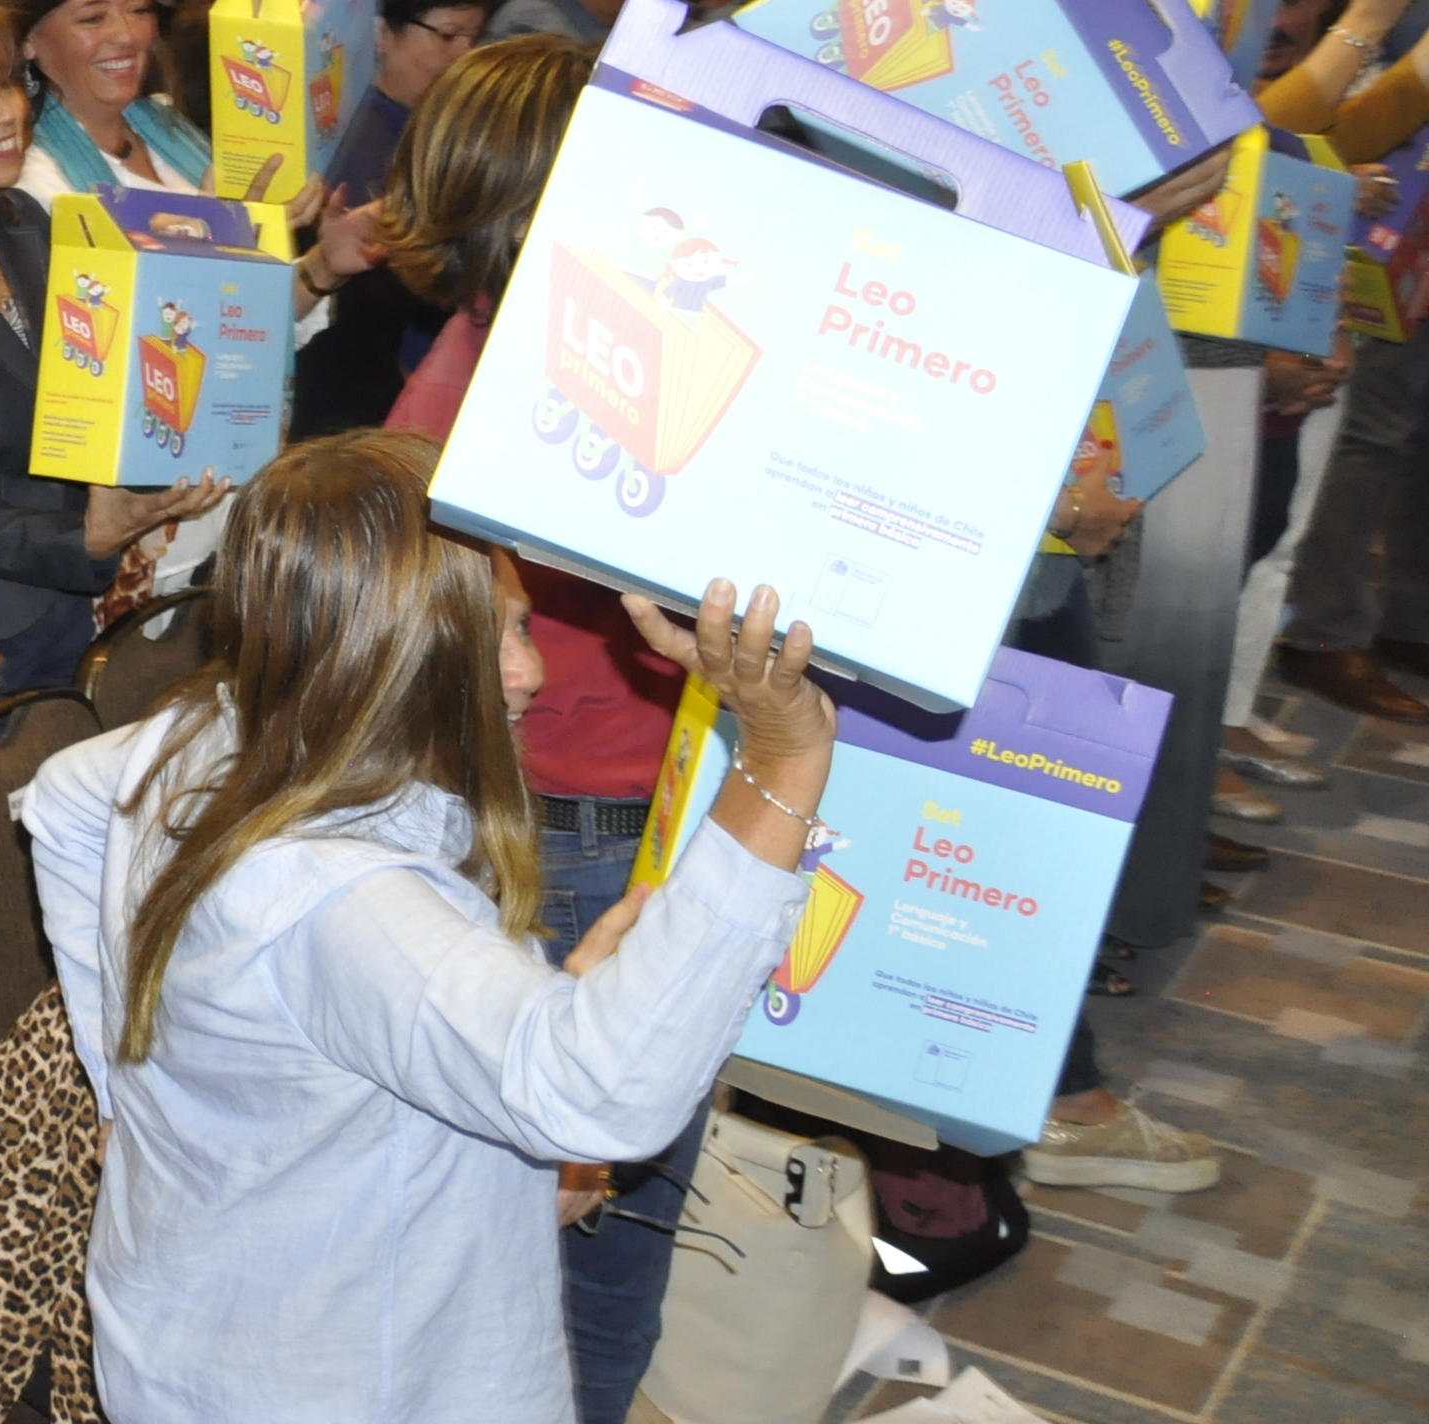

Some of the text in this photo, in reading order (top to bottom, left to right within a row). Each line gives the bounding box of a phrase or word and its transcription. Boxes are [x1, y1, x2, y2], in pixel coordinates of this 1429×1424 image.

[230, 68, 263, 94] LEO
[1015, 60, 1050, 107] Leo
[1108, 38, 1180, 146] #LeoPrimero
[989, 73, 1056, 170] Primero
[851, 227, 904, 267] Set
[220, 301, 243, 318] Leo
[832, 260, 917, 317] Leo
[62, 311, 91, 339] LEO
[218, 323, 267, 342] Primero
[561, 298, 644, 398] LEO
[817, 304, 997, 396] Primero
[144, 362, 175, 401] LEO
[558, 350, 640, 426] primero
[764, 466, 822, 493] aprendan
[835, 490, 859, 508] leer
[861, 502, 980, 552] comprensivamente
[770, 451, 794, 467] Que
[797, 461, 830, 481] todos
[833, 475, 850, 489] los
[853, 483, 886, 502] niños
[899, 501, 931, 519] niñas
[935, 515, 950, 526] de
[953, 520, 985, 539] Chile
[812, 500, 919, 546] en primero básico
[969, 738, 1123, 795] #LeoPrimero
[922, 800, 962, 826] Set
[912, 826, 974, 864] Leo
[903, 858, 1038, 916] Primero
[890, 912, 988, 948] Comunicación
[894, 899, 957, 928] Lenguaje
